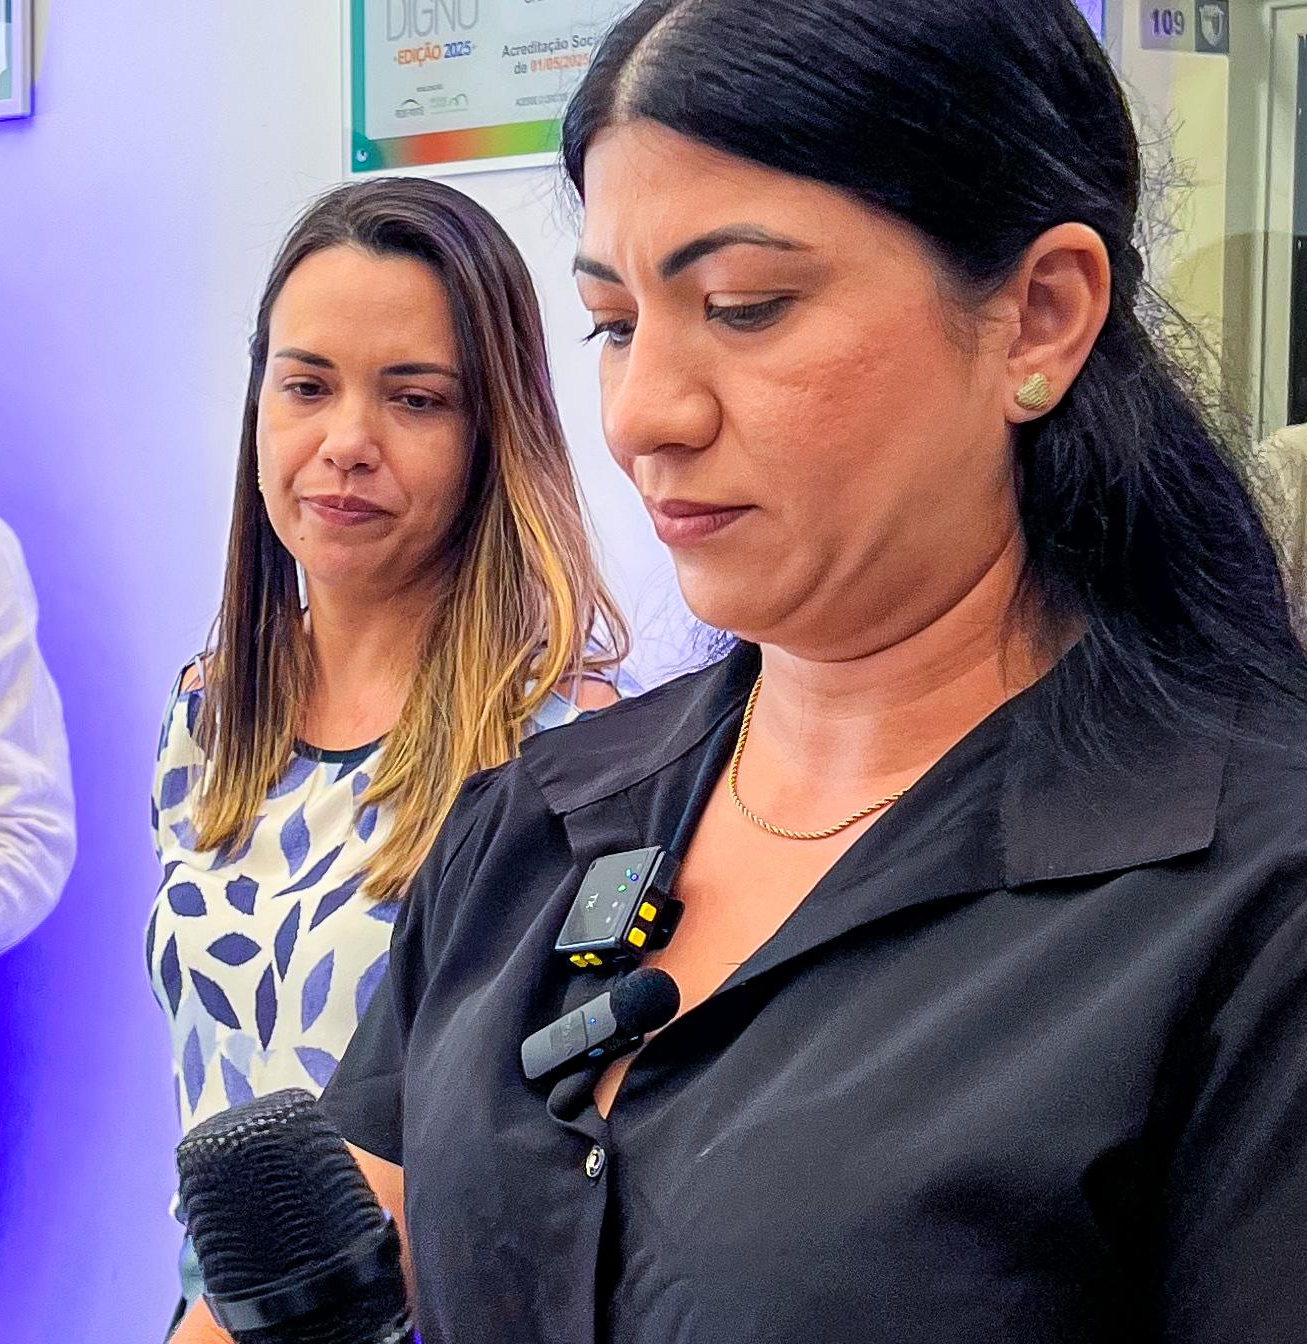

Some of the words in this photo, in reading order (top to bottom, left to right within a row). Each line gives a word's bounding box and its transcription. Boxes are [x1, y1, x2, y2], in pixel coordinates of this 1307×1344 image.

[1151, 8, 1185, 36] 109
[444, 41, 471, 59] 2025
[502, 38, 569, 57] Acreditação
[514, 61, 527, 74] de
